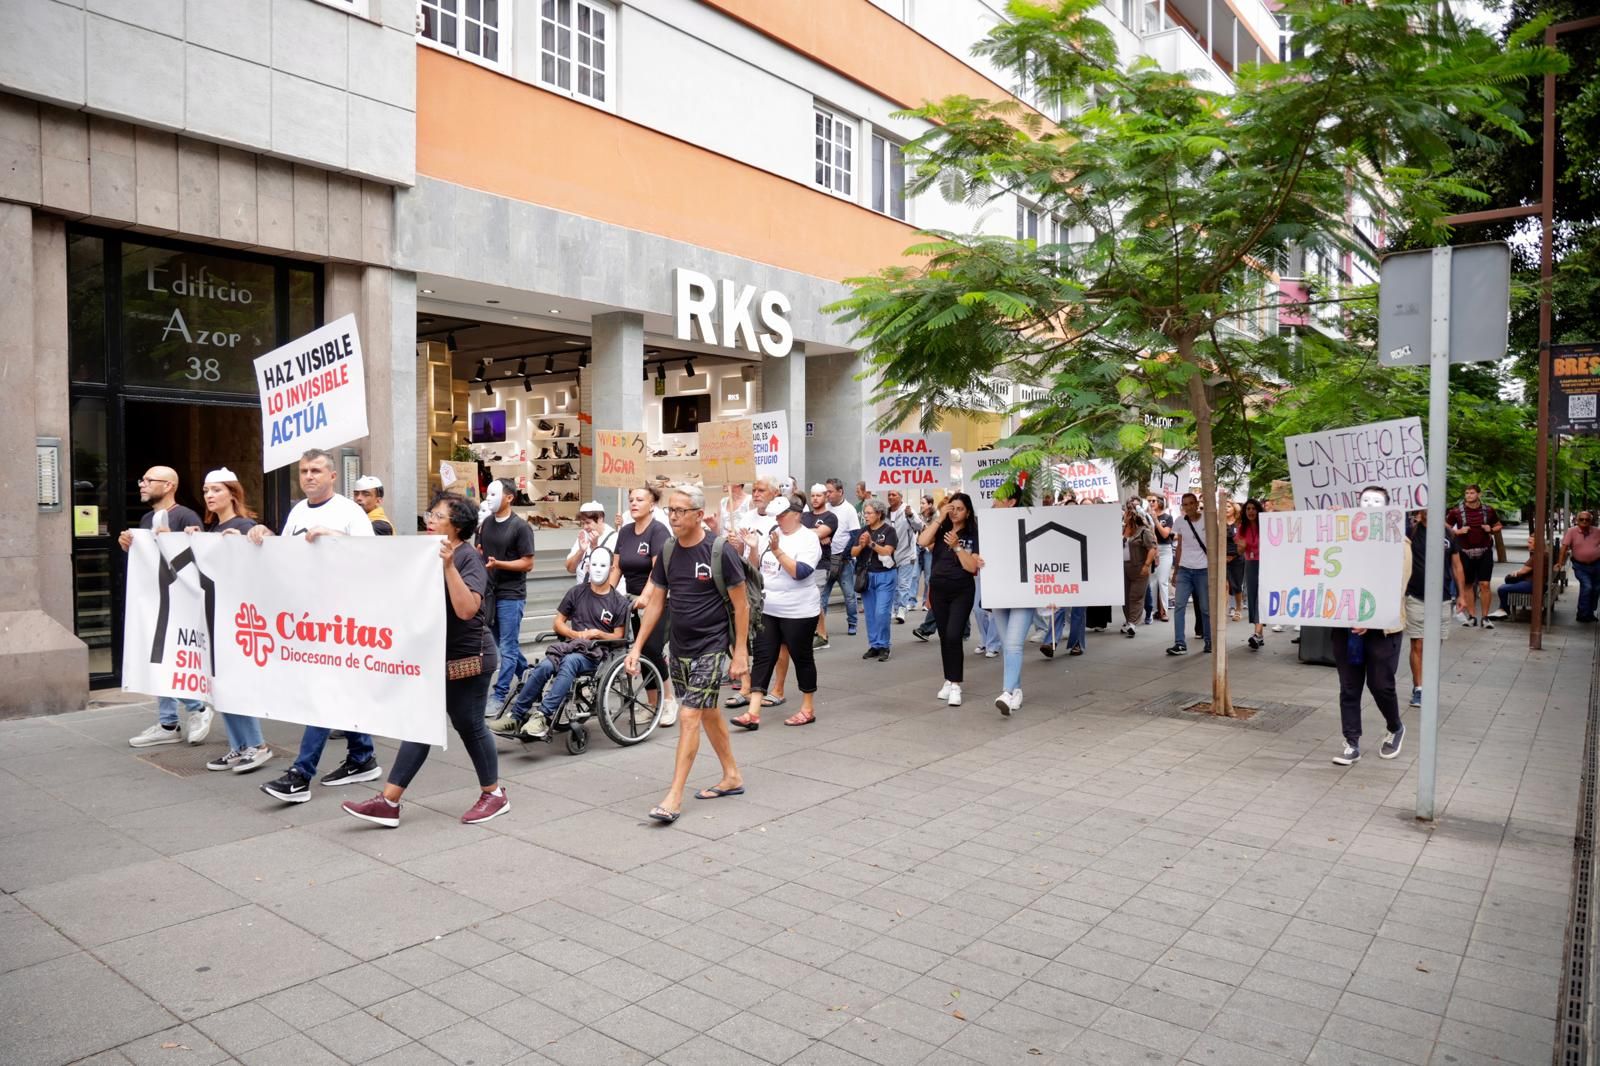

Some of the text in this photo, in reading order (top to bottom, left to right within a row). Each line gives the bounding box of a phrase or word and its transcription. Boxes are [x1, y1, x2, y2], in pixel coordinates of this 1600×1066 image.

[147, 259, 253, 304] Edificio
[162, 308, 241, 348] Azor
[672, 267, 794, 358] RKS
[185, 357, 220, 381] 38
[264, 333, 353, 391] HAZ VISIBLE
[267, 363, 349, 416] LO INVISIBLE
[270, 401, 328, 448] ACTÚA
[878, 454, 943, 467] ACÉRCATE.
[879, 438, 933, 453] PARA.
[1294, 424, 1423, 467] UN TECHO ES
[878, 467, 939, 485] ACTÚA.
[1267, 509, 1403, 547] UN HOGAR
[1034, 563, 1071, 573] NADIE
[1034, 574, 1055, 584] SIN
[1303, 546, 1343, 578] ES
[1034, 583, 1080, 595] HOGAR
[1268, 583, 1377, 622] DIGNIDAD
[276, 611, 393, 650] Cáritas
[176, 650, 202, 670] SIN
[280, 645, 421, 676] Diocesana de Canarias
